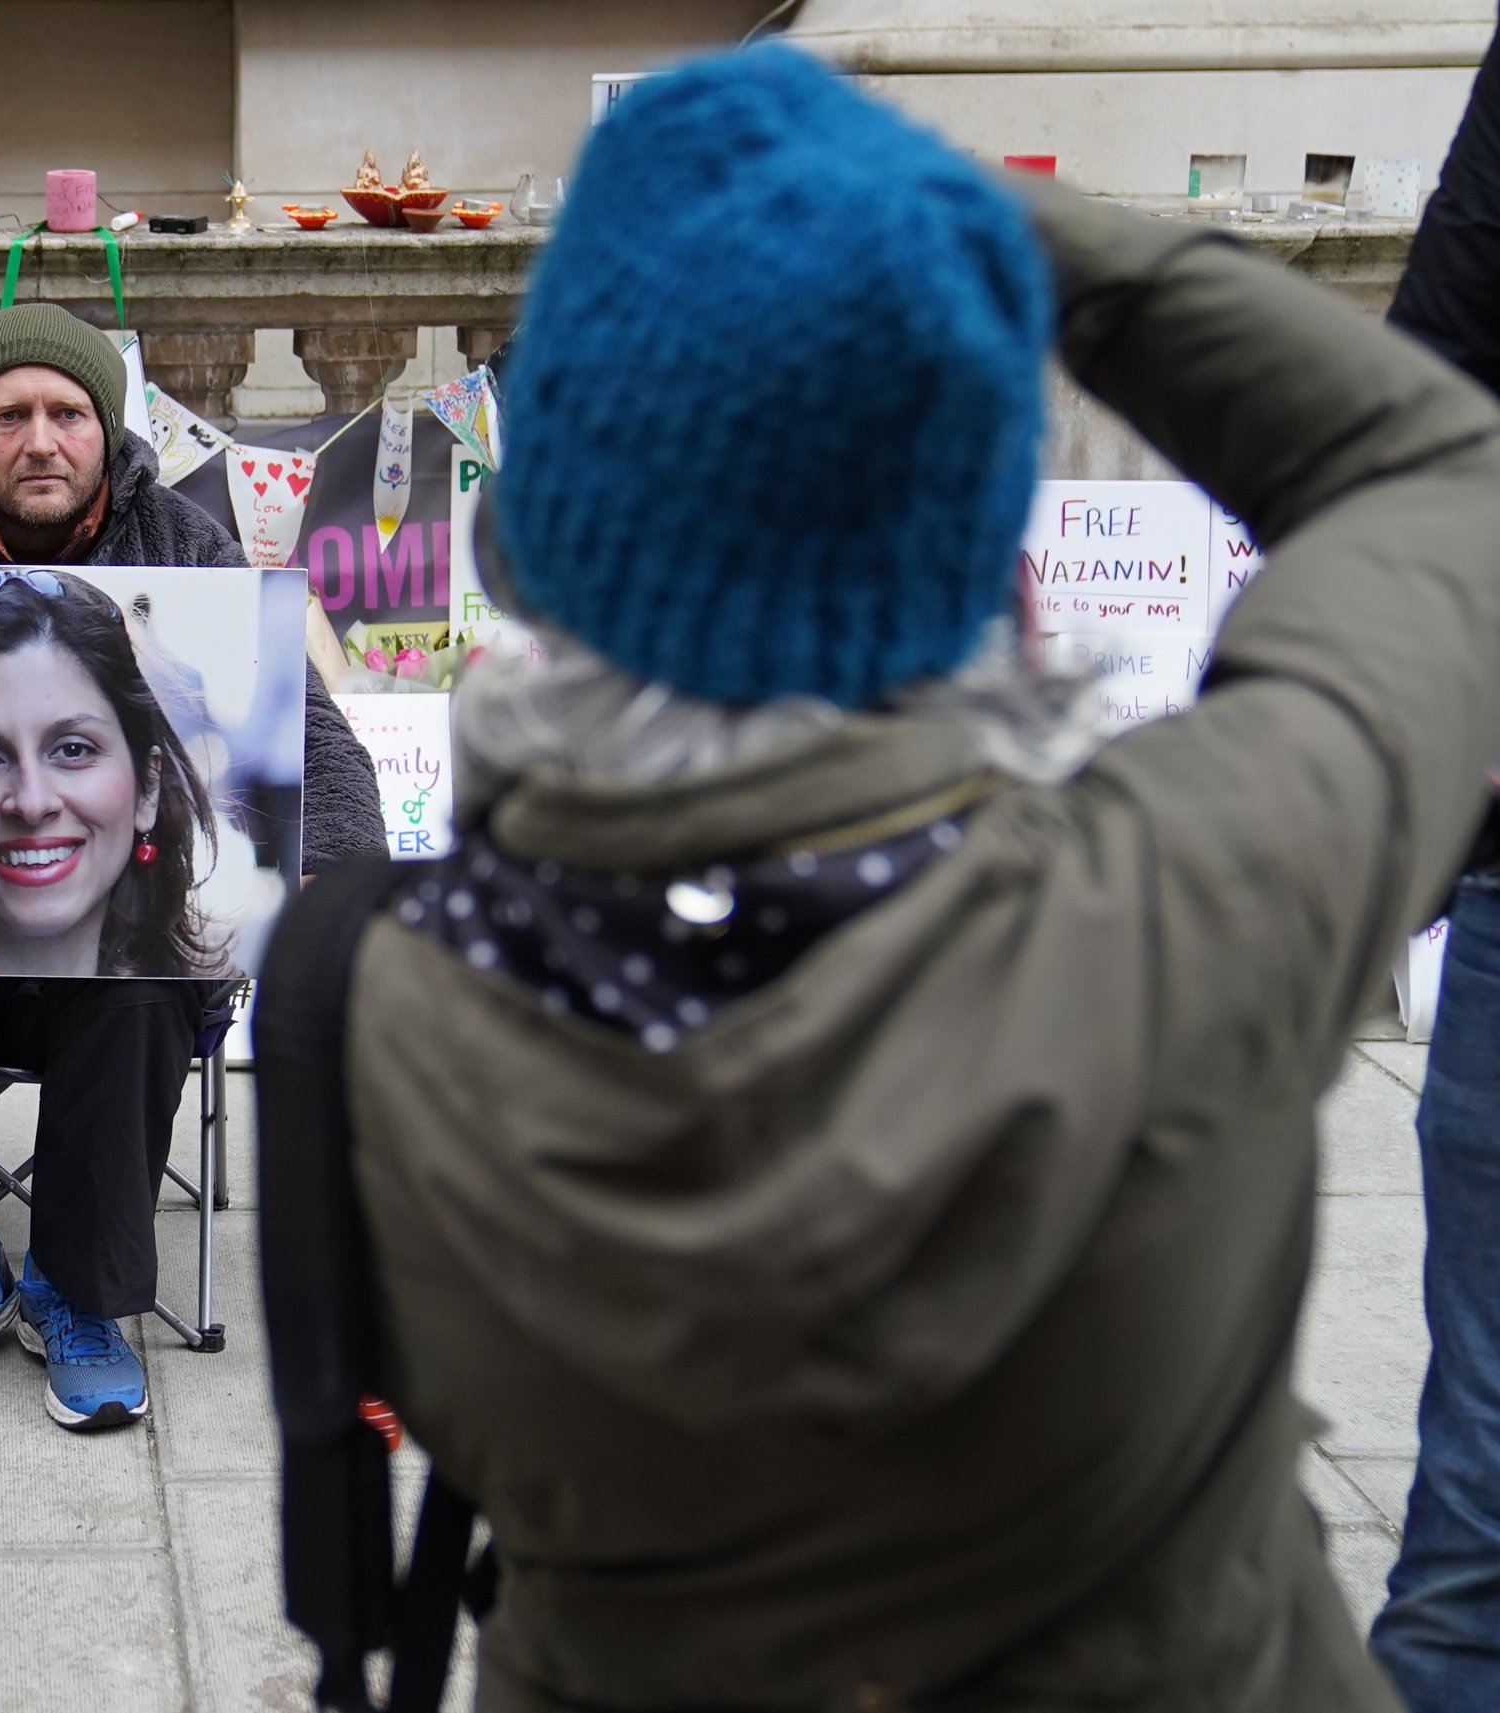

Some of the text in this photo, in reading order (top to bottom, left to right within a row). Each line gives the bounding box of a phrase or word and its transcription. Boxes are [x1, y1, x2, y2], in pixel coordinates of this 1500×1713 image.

[253, 497, 283, 514] Love
[1061, 499, 1142, 537] FREE
[307, 520, 450, 612] OM
[1073, 598, 1089, 612] to
[1099, 602, 1136, 618] your
[1147, 604, 1181, 622] MP!
[376, 747, 440, 791] mily
[402, 791, 431, 824] of
